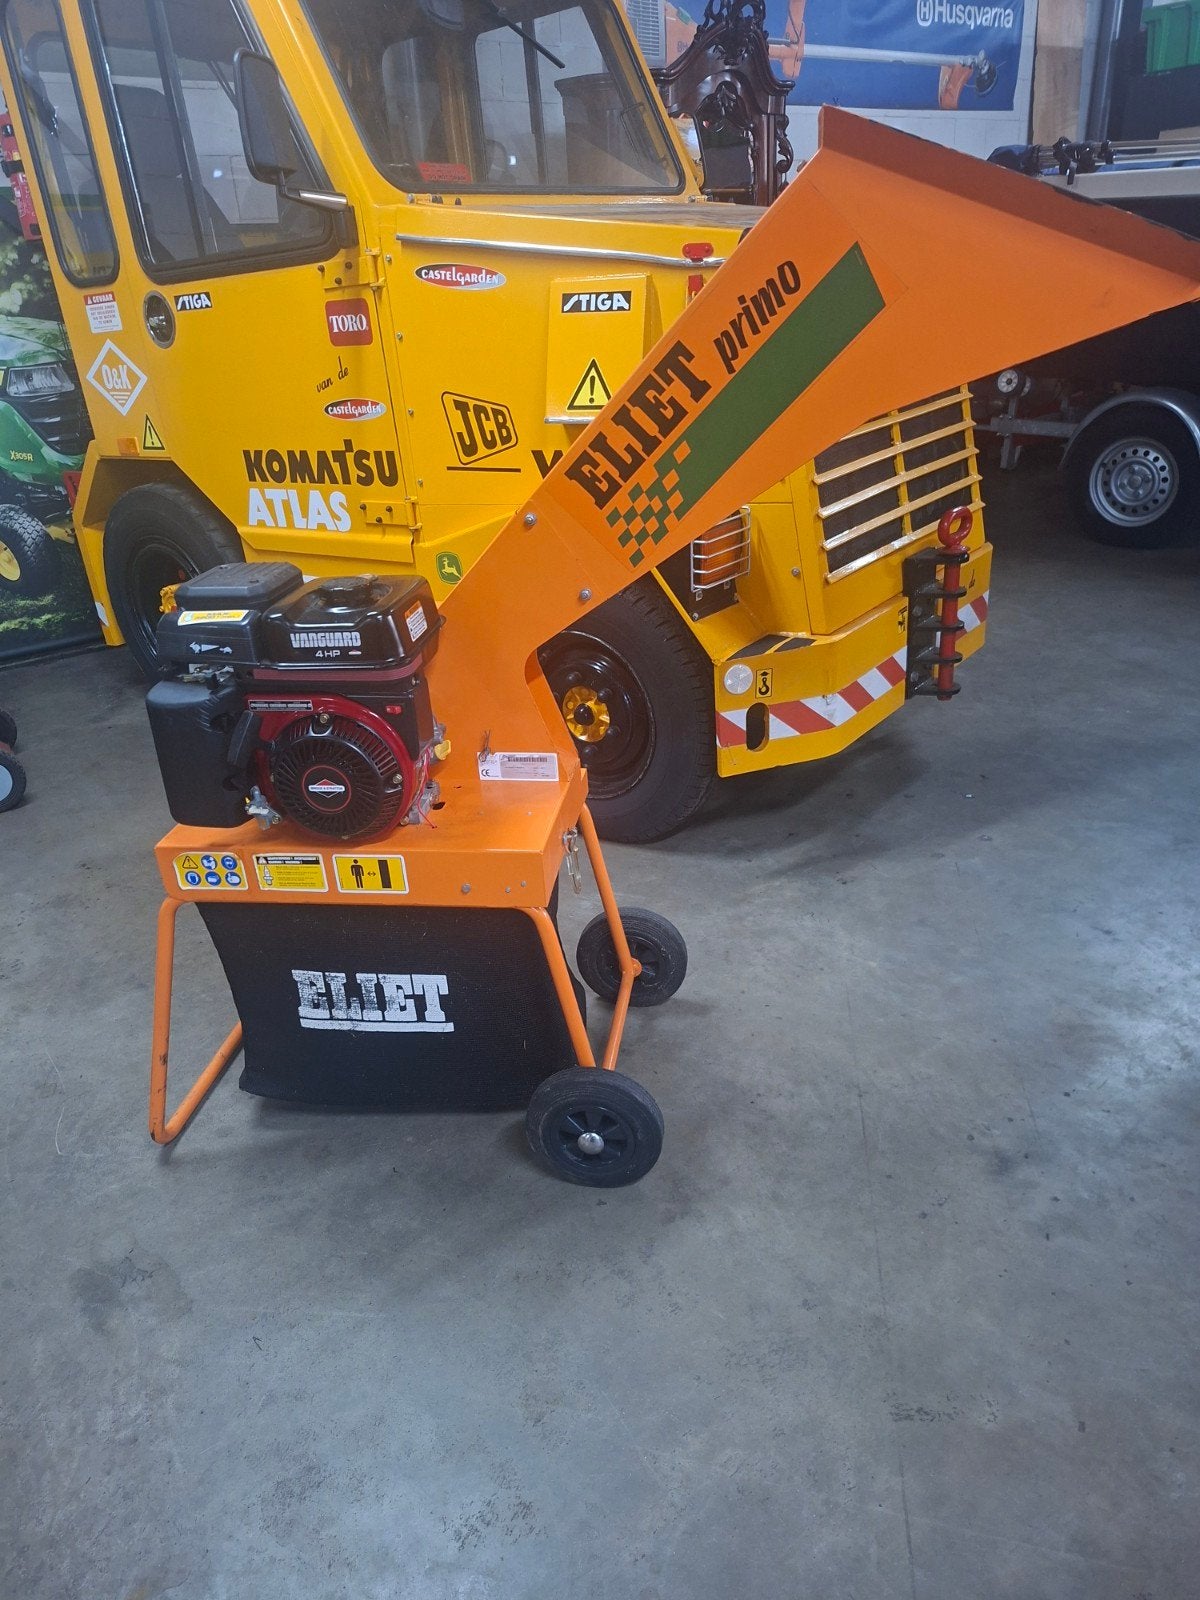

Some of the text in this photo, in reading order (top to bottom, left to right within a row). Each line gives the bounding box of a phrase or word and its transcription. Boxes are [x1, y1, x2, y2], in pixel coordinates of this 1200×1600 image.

[934, 0, 1014, 30] Husqvarna
[175, 294, 212, 310] STIGA
[562, 293, 630, 312] STIGA
[329, 313, 368, 333] TORO
[101, 364, 132, 390] O&K
[316, 355, 349, 393] van de
[564, 259, 802, 510] ELIET primo
[453, 399, 511, 458] JCB
[9, 449, 34, 462] X305R
[242, 438, 399, 487] KOMATSU
[247, 487, 352, 533] ATLAS
[289, 631, 362, 648] VANGUARD
[290, 968, 449, 1022] ELIET
